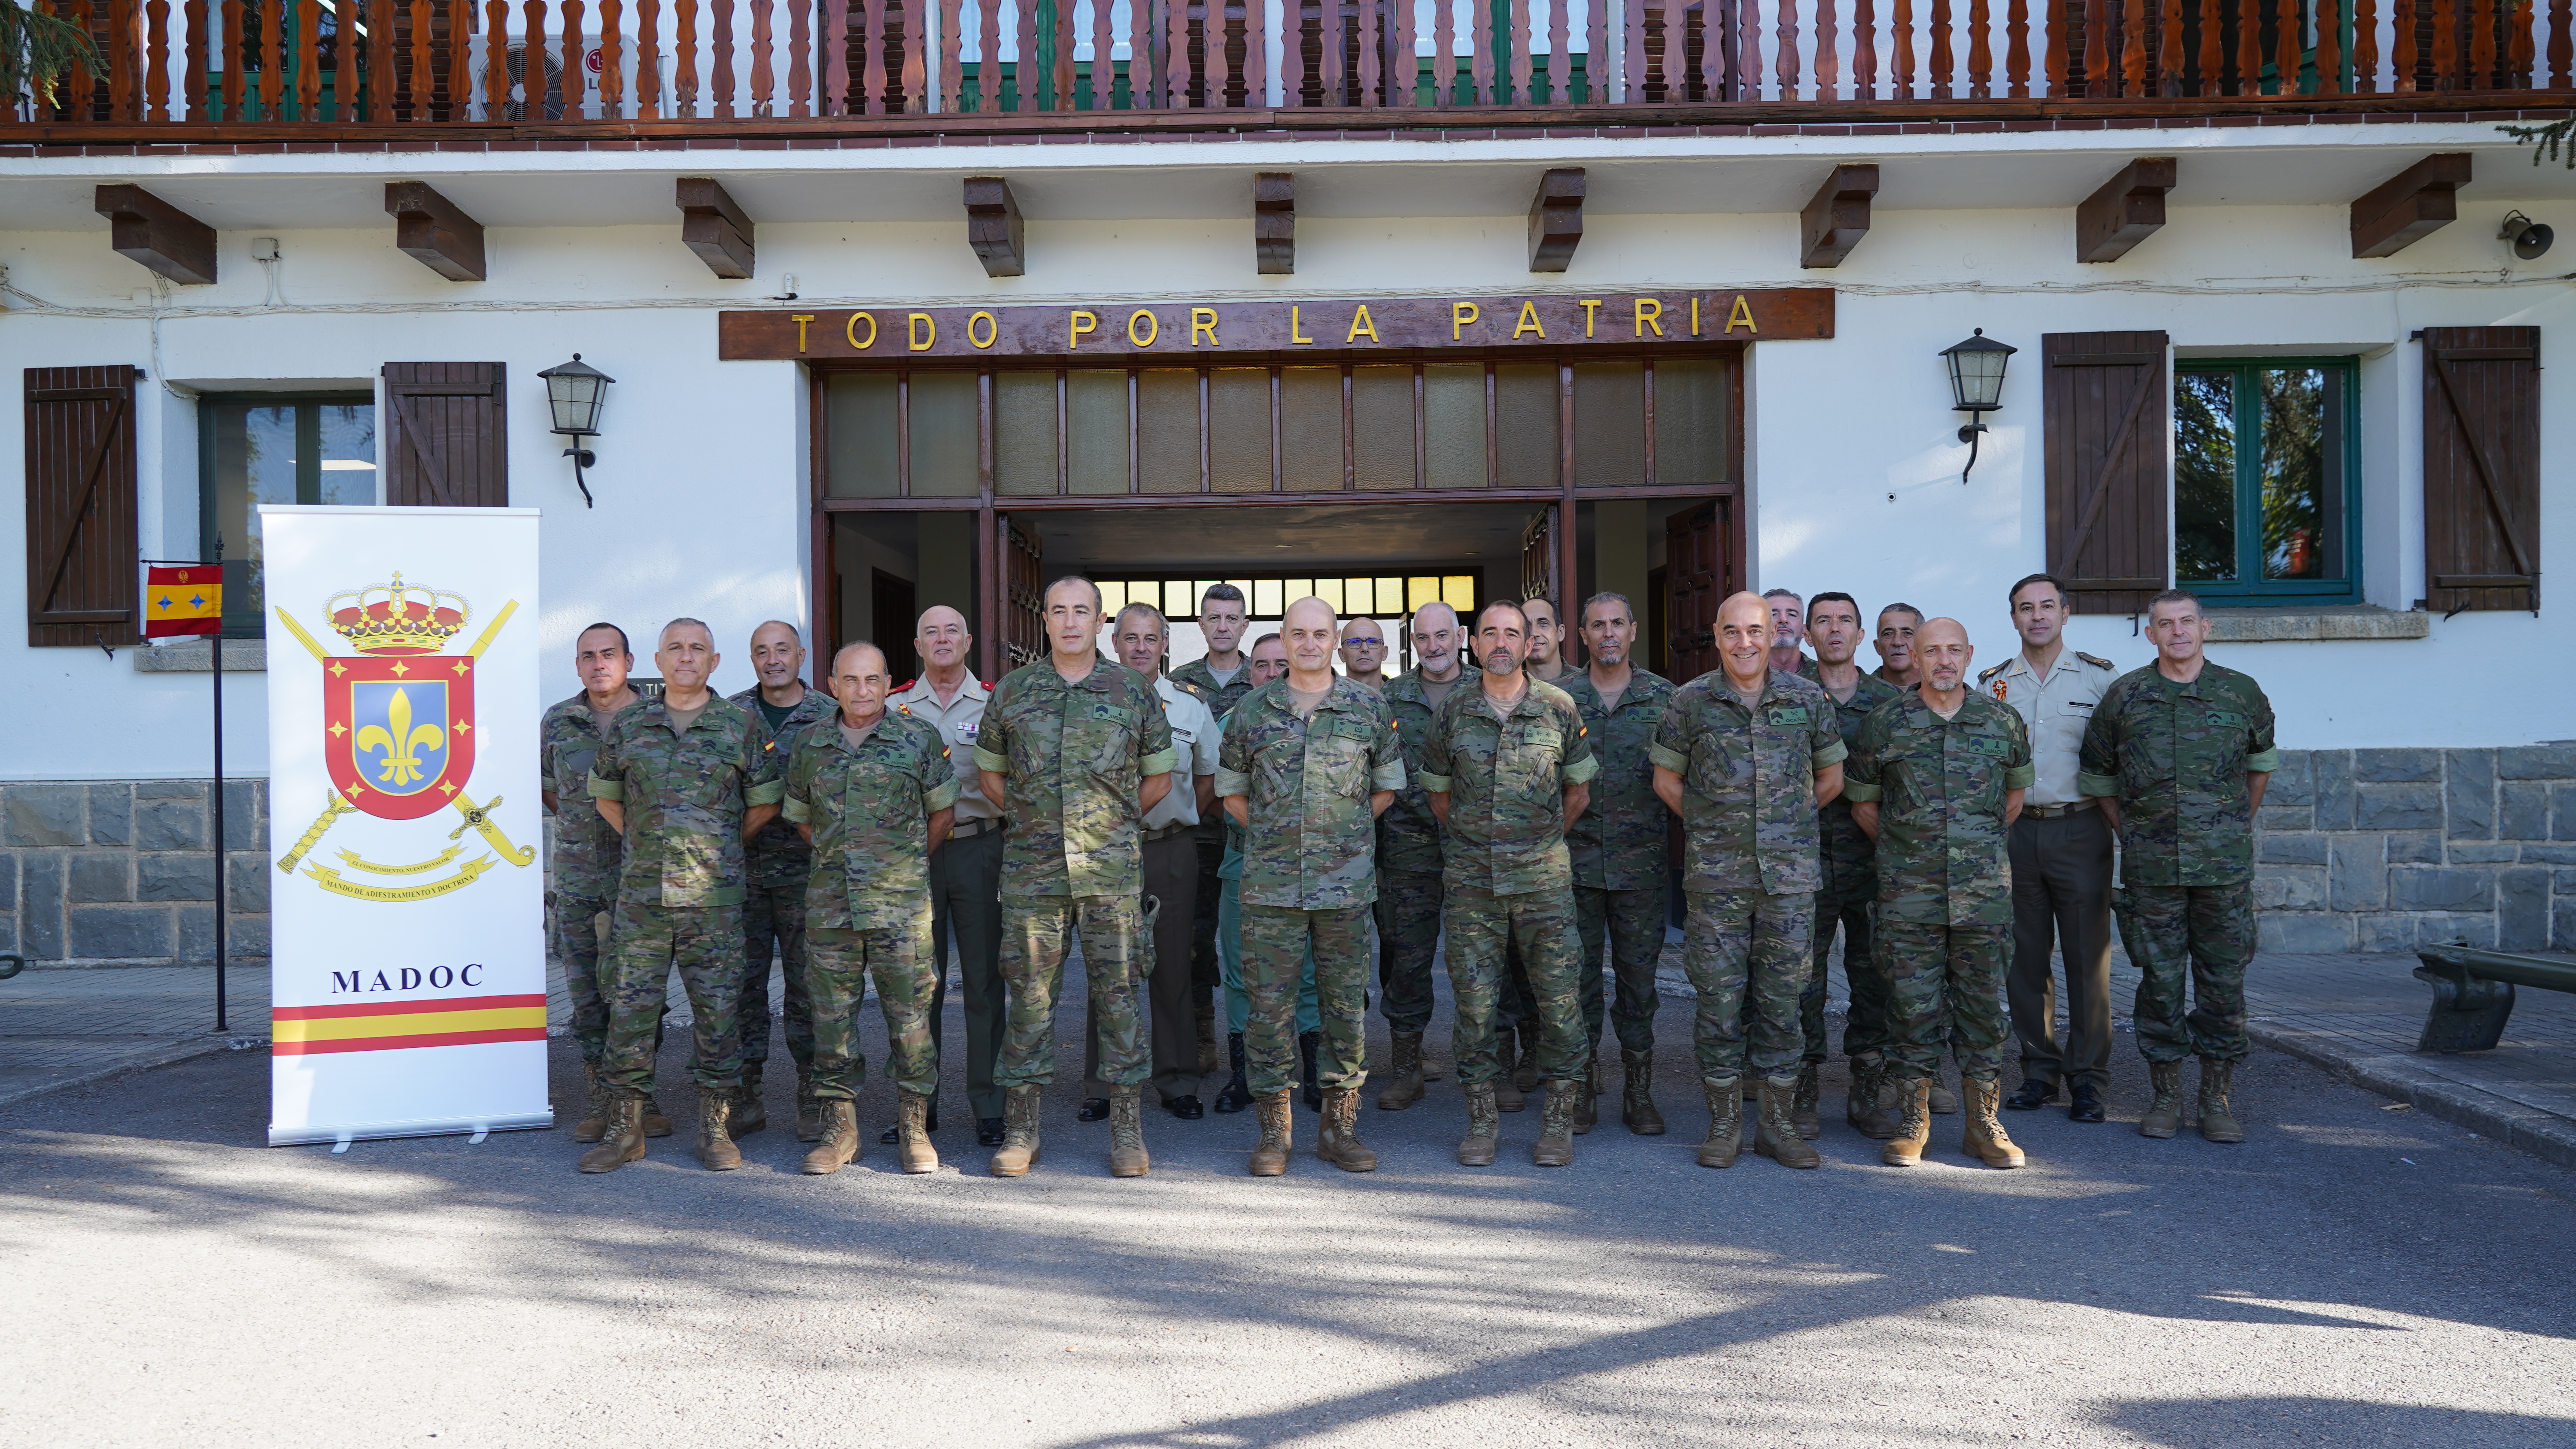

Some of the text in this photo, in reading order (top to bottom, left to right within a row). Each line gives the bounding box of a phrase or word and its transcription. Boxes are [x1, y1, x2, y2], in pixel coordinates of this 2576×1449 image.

[792, 295, 1758, 353] TODO POR LA PATRIA
[1346, 731, 1369, 740] CASTRILLO
[360, 863, 405, 873] CONOCIMIENTO,
[406, 864, 431, 872] NUESTRO
[431, 856, 450, 866] VALOR
[325, 880, 353, 893] MANDO
[365, 889, 431, 898] ADIESTRAMIENTO
[437, 875, 474, 892] DOCTRINA
[331, 964, 483, 994] MADOC
